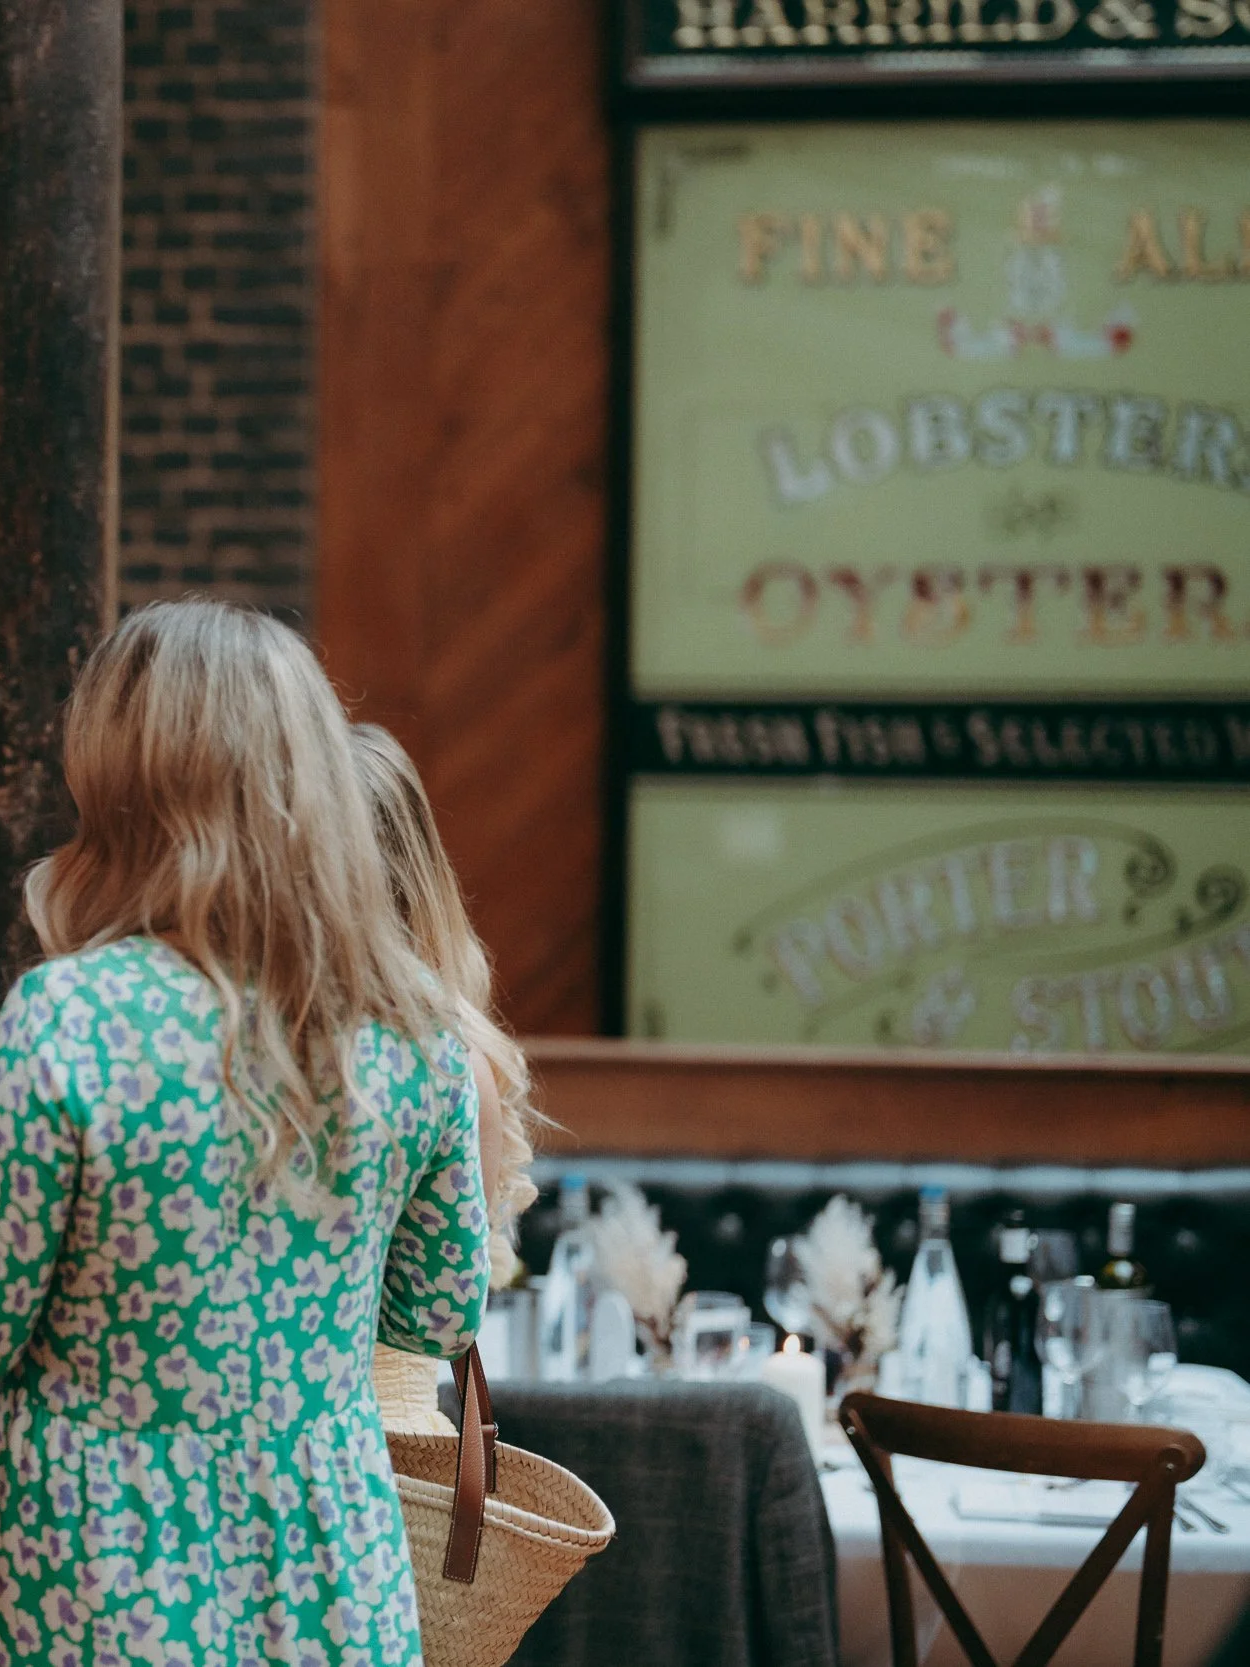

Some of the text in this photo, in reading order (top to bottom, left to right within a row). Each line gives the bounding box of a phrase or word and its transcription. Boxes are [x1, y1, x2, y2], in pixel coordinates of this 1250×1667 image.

[736, 205, 1250, 286] FINE AL
[757, 388, 1250, 506] LOBSTER
[740, 560, 1250, 648] OYSTER
[769, 836, 1102, 1005] PORTER
